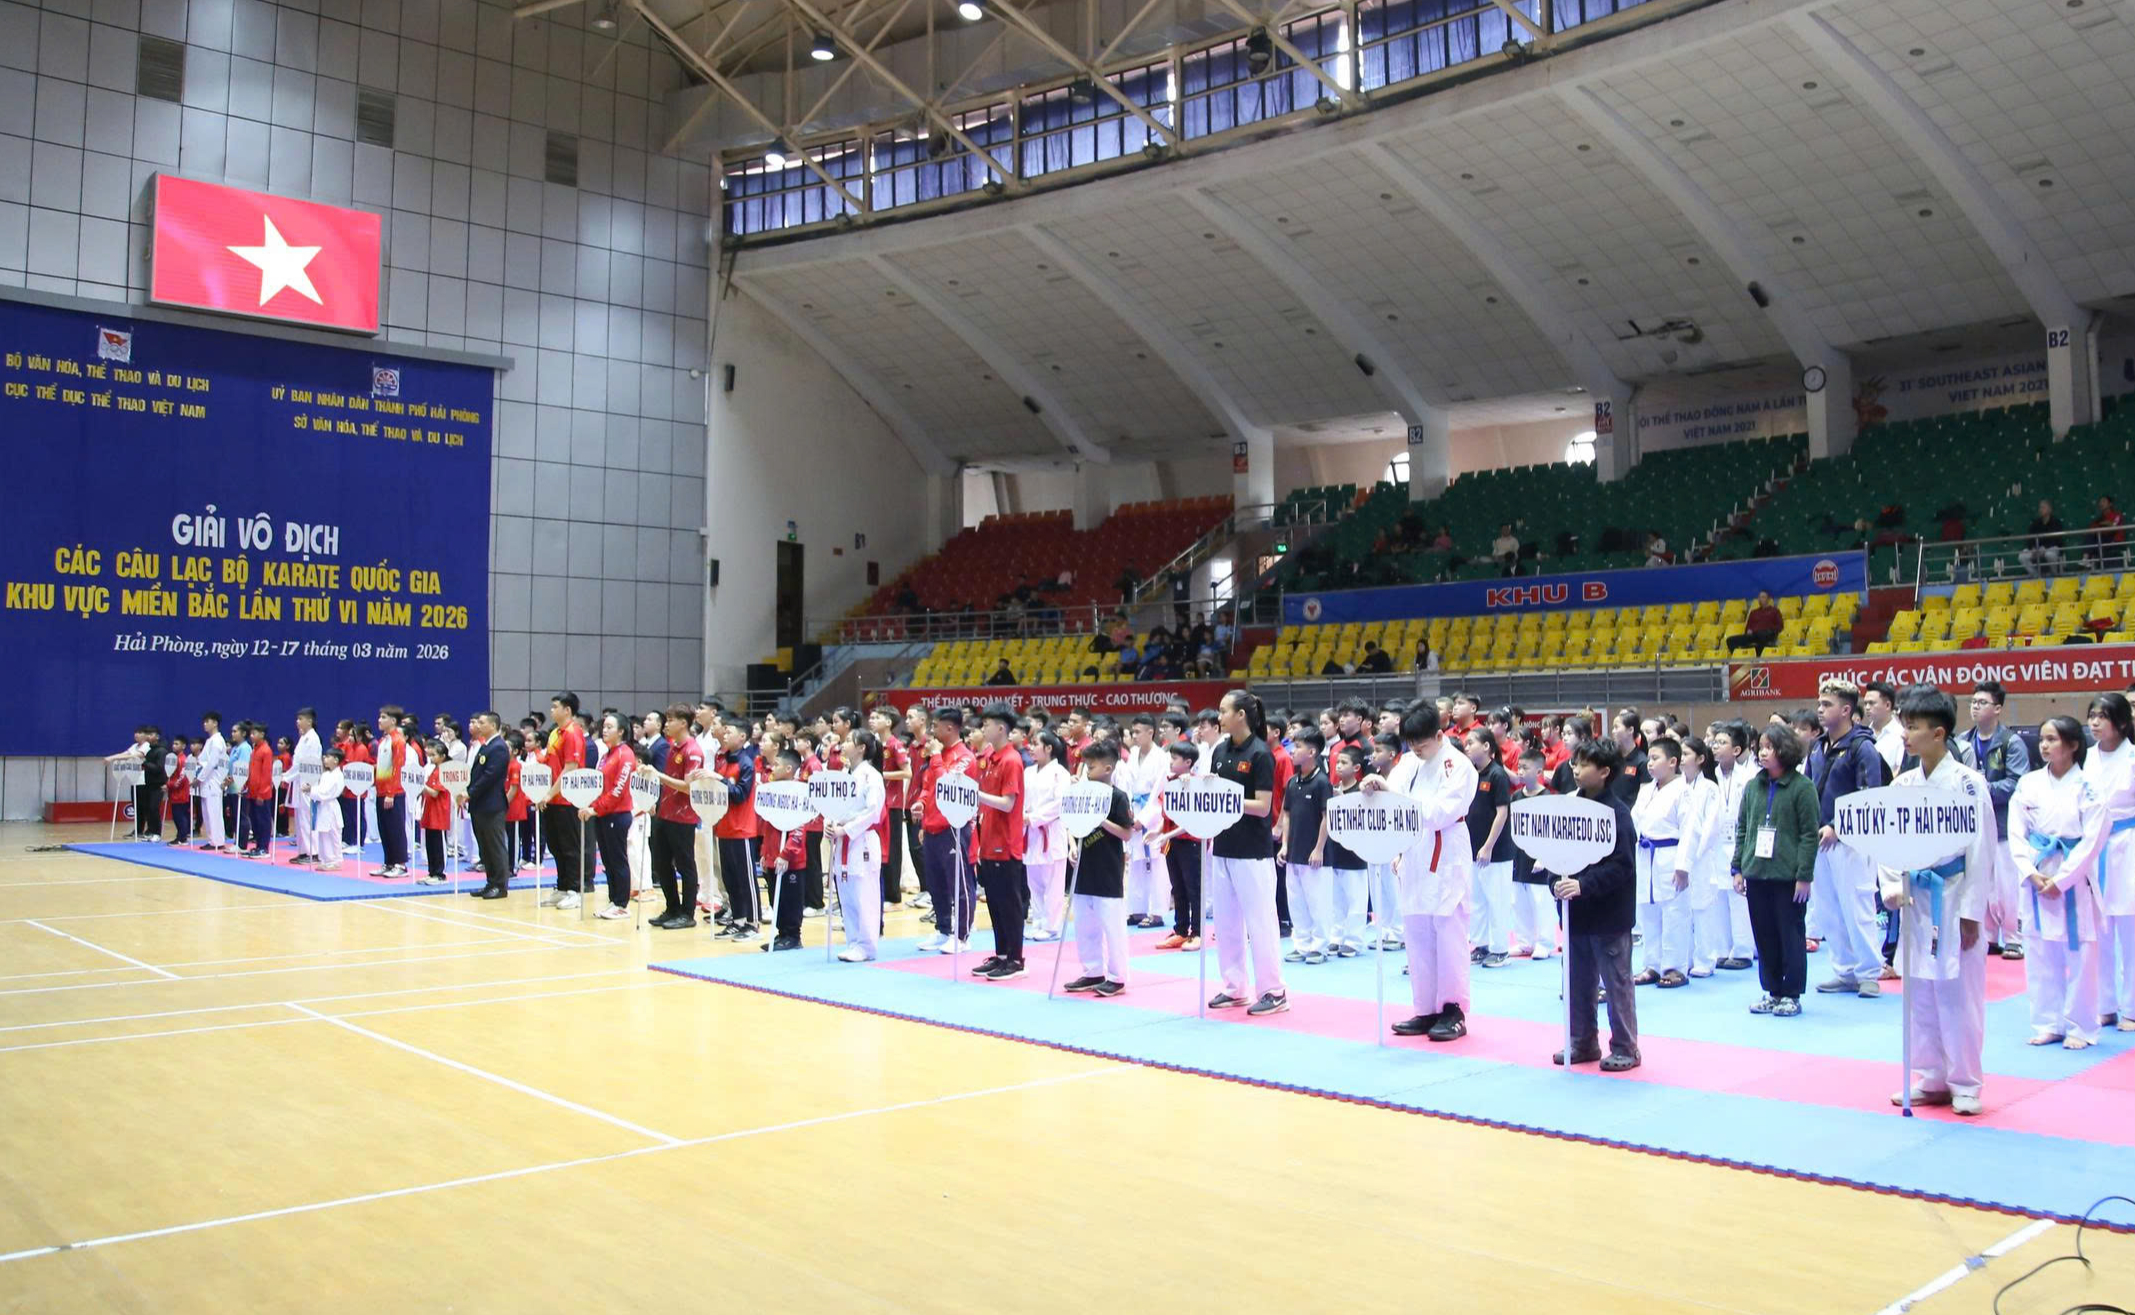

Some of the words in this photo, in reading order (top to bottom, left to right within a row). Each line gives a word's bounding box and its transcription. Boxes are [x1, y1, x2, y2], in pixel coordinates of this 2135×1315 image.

[2048, 330, 2069, 349] B2
[6, 352, 22, 370] BỘ
[114, 368, 142, 384] THAO
[167, 375, 181, 389] DU
[187, 376, 210, 393] LỊCH
[1918, 366, 1998, 389] SOUTHEAST
[2003, 359, 2047, 377] ASIAN
[291, 389, 312, 403] BAN
[1983, 383, 2015, 399] NAM
[118, 396, 146, 412] THAO
[181, 404, 206, 418] NAM
[1596, 401, 1611, 417] B2
[1674, 411, 1700, 423] THAO
[1736, 402, 1761, 415] NAM
[384, 426, 407, 441] THAO
[428, 431, 440, 444] DU
[1409, 428, 1422, 443] B2
[1708, 424, 1731, 437] NAM
[1734, 421, 1756, 433] 2021
[172, 504, 226, 548] GIẢI
[238, 512, 273, 551] VÔ
[285, 521, 339, 561] ĐỊCH
[55, 544, 101, 576] CÁC
[116, 547, 159, 579] CÂU
[172, 555, 212, 588] LẠC
[222, 553, 249, 590] BỘ
[263, 561, 340, 590] KARATE
[351, 558, 400, 593] QUỐC
[410, 570, 441, 595] GIA
[6, 582, 55, 610] KHU
[64, 585, 110, 619] VỰC
[121, 582, 178, 616] MIỀN
[188, 583, 229, 619] BẮC
[239, 587, 281, 621] LẦN
[339, 600, 358, 624] VI
[367, 597, 411, 627] NĂM
[420, 604, 468, 630] 2026
[1487, 583, 1568, 607] KHU
[1583, 581, 1608, 601] B
[114, 631, 147, 651] Hải
[151, 635, 209, 658] Phòng,
[212, 638, 248, 659] ngày
[303, 641, 348, 661] tháng
[352, 643, 372, 658] 03
[376, 643, 408, 659] năm
[416, 644, 449, 660] 2026
[1872, 665, 1909, 687] CÁC
[2020, 659, 2067, 682] VIÊN
[2072, 660, 2114, 684] ĐẠT
[1030, 695, 1066, 707] TRUNG
[1068, 692, 1098, 709] THỰC
[1106, 693, 1128, 706] CAO
[1740, 689, 1781, 697] AGRIBANK
[562, 776, 568, 789] TP
[809, 777, 828, 798] PHÚ
[831, 781, 848, 801] THỌ
[850, 782, 856, 798] 2
[937, 780, 957, 802] PHÚ
[958, 787, 976, 811] THỌ
[1165, 787, 1190, 812] THÁI
[1194, 788, 1241, 814] NGUYÊN
[1367, 808, 1387, 831] CLUB
[1394, 804, 1404, 832] HÀ
[1406, 805, 1419, 836] NỘI
[1513, 812, 1529, 836] VIET
[1532, 813, 1549, 838] NAM
[1552, 815, 1592, 842] KARATEDO
[1595, 818, 1611, 843] JSC
[1856, 802, 1870, 835] TỨ
[1873, 801, 1886, 835] KỲ
[1897, 807, 1910, 834] TP
[1915, 797, 1934, 834] HẢI
[1937, 799, 1976, 834] PHÒNG
